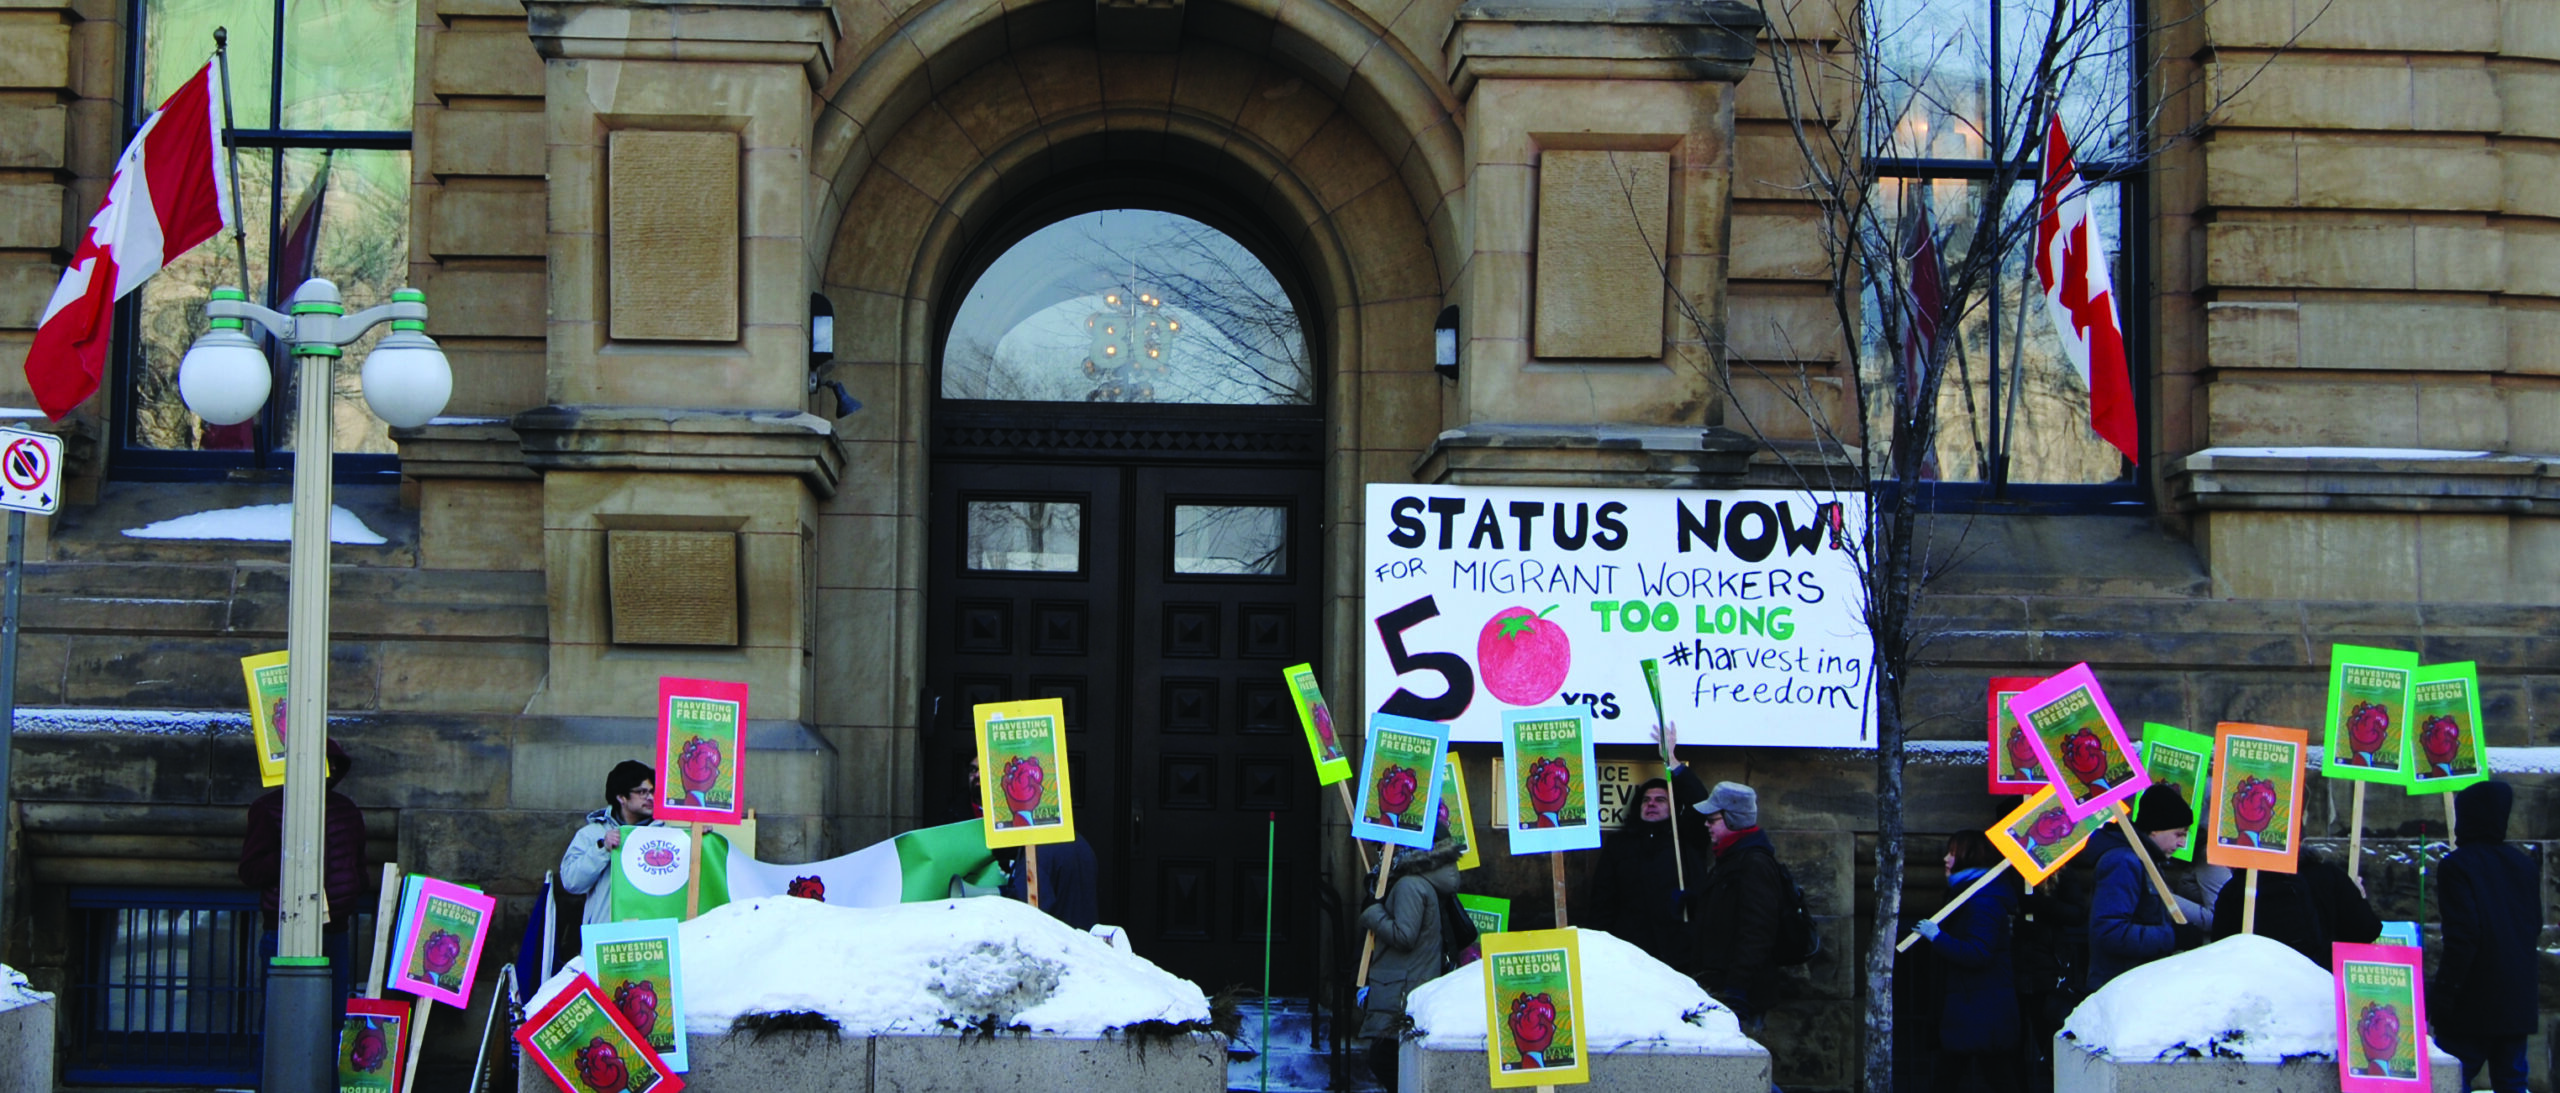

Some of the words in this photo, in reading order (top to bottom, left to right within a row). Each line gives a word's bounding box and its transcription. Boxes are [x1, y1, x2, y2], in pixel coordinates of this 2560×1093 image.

[1387, 496, 1628, 551] STATUS
[1677, 497, 1843, 562] NOW!
[1375, 557, 1427, 582] FOR
[1453, 559, 1620, 594] MIGRANT
[1638, 562, 1824, 603] WORKERS
[1591, 600, 1679, 632] TOO
[1696, 604, 1795, 640] LONG
[1663, 639, 1860, 688] #harvesting
[2347, 668, 2401, 680] HARVESTING
[2347, 675, 2401, 689] FREEDOM
[2416, 683, 2461, 693] ARVESTING
[1692, 673, 1858, 710] freedom
[2417, 690, 2463, 702] REEDOM
[677, 701, 731, 713] HARVESTING
[2033, 690, 2084, 720] HARVESTING
[676, 709, 731, 723] FREEDOM
[2037, 697, 2090, 729] FREEDOM
[992, 720, 1047, 731] HARVESTING
[1519, 721, 1575, 732] HARVESTING
[992, 728, 1048, 741] FREEDOM
[1381, 732, 1432, 747] HARVESTING
[1520, 729, 1576, 742] FREEDOM
[1380, 740, 1431, 755] FREEDOM
[2154, 746, 2196, 762] HARVESTING
[2233, 740, 2289, 754] HARVESTING
[2153, 753, 2194, 771] FREEDOM
[2232, 748, 2289, 763] FREEDOM
[1598, 766, 1629, 781] ICE
[639, 840, 680, 855] JUSTICIA
[637, 862, 679, 876] JUSTICE
[430, 905, 475, 925] FREEDOM
[432, 899, 477, 918] HARVESTING
[602, 941, 663, 954] HARVESTING
[603, 949, 664, 965] FREEDOM
[1498, 953, 1560, 966] HARVESTING
[1499, 962, 1561, 976] FREEDOM
[2350, 965, 2406, 976] HARVESTING
[2351, 974, 2407, 987] FREEDOM
[539, 997, 587, 1041] HARVESTING
[544, 1004, 595, 1050] FREEDOM
